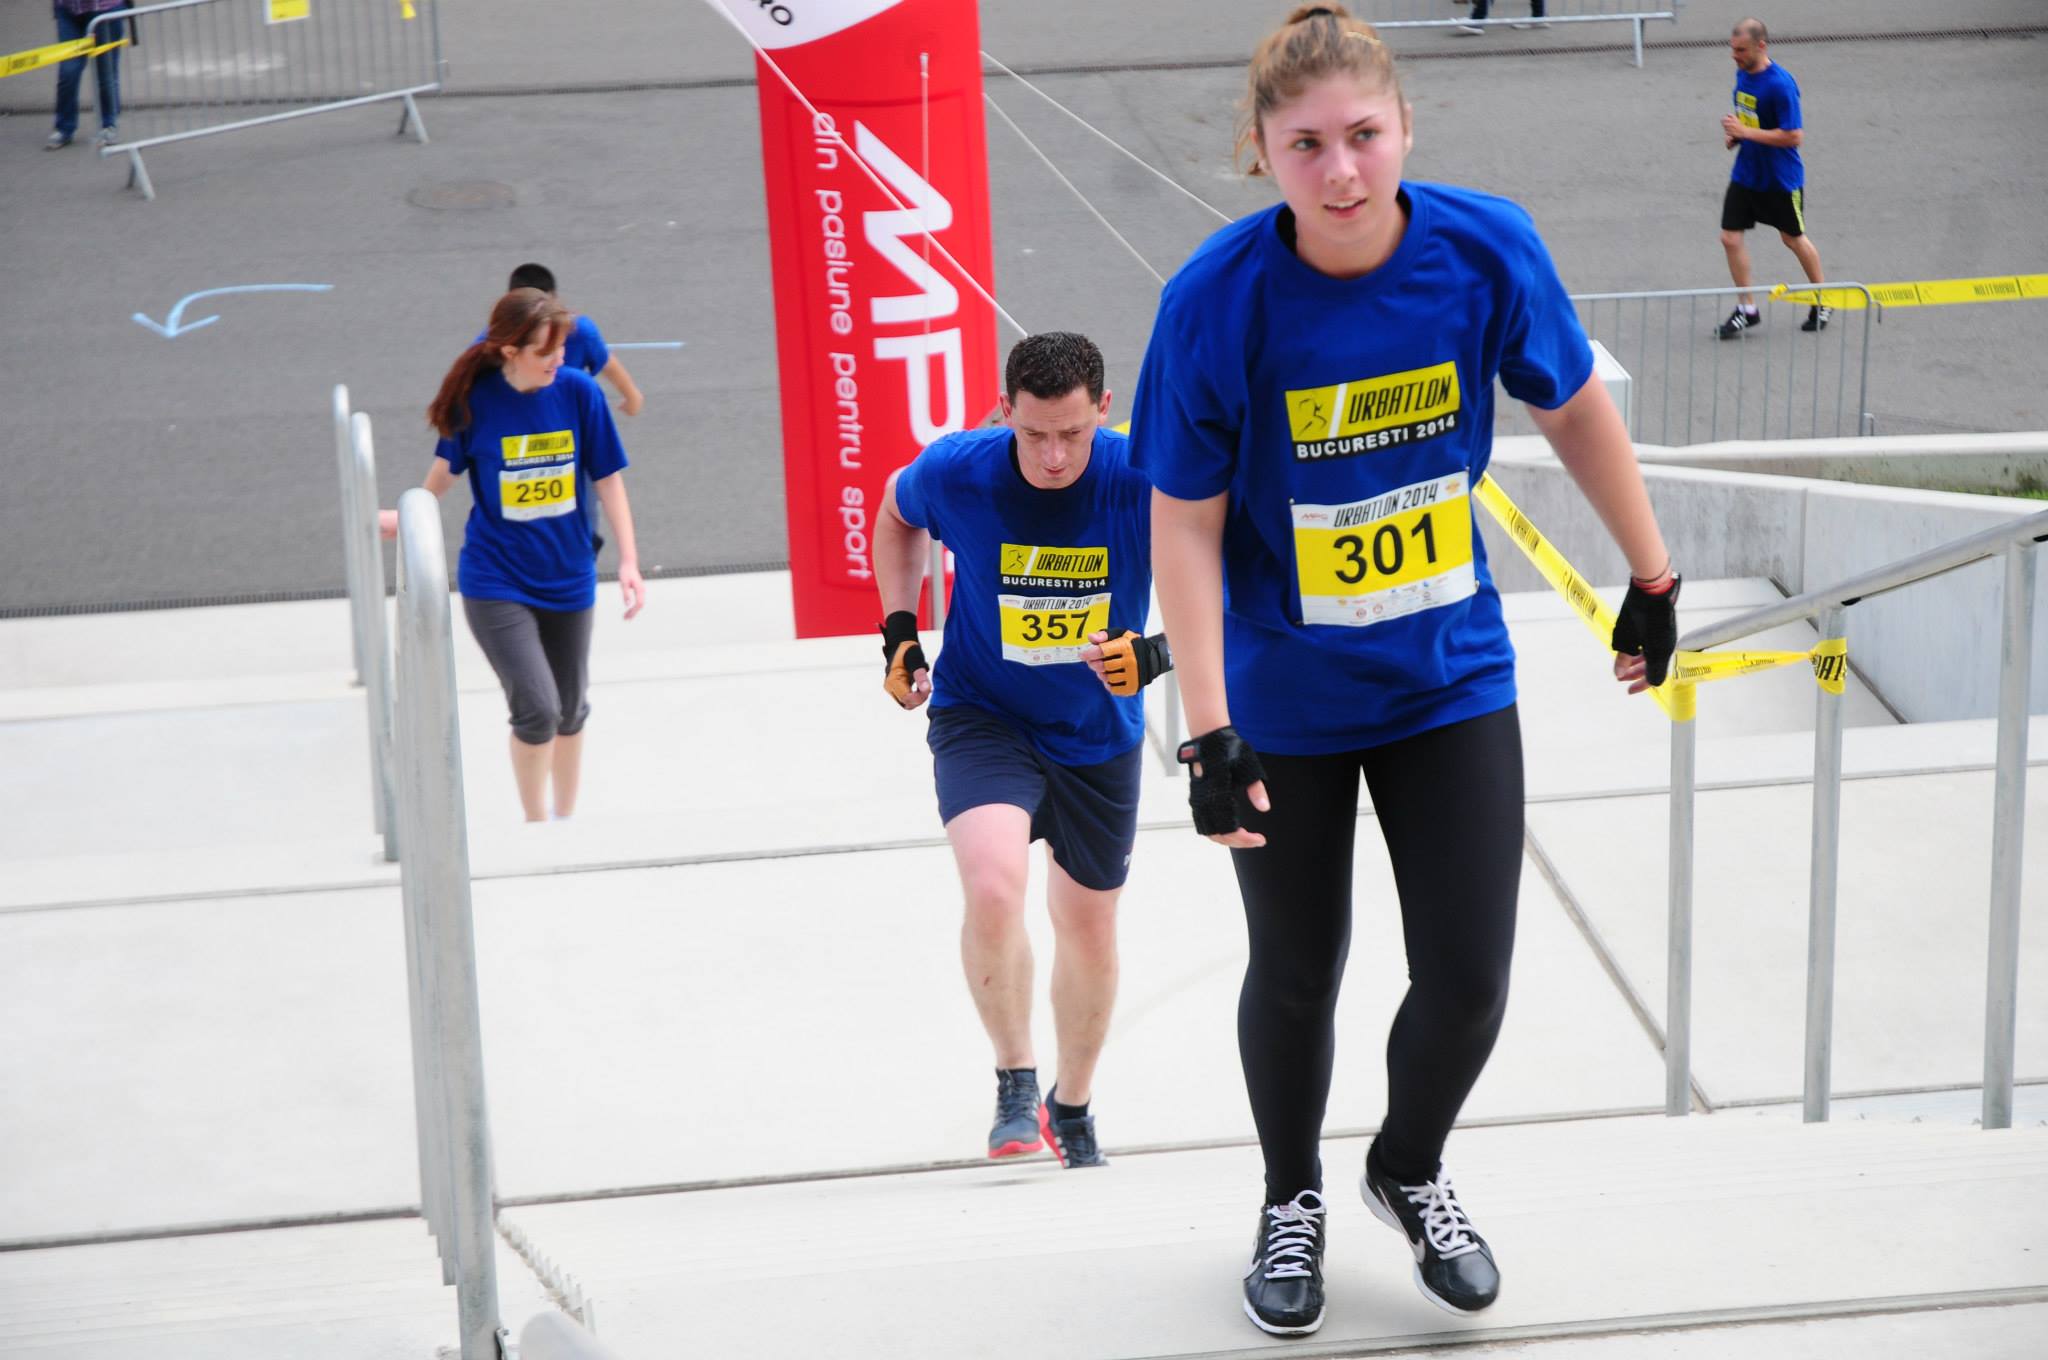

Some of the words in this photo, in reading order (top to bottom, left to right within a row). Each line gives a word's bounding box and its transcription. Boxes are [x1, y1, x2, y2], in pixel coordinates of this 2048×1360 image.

[812, 111, 842, 170] din
[815, 188, 854, 335] pasiune
[853, 119, 967, 576] MP
[829, 352, 865, 469] pentru
[1347, 375, 1452, 424] URBATLON
[1296, 428, 1408, 459] BUCURESTI
[1416, 414, 1456, 439] 2014
[516, 479, 562, 503] 250
[1402, 482, 1439, 511] 2014
[837, 486, 873, 580] sport
[1333, 512, 1438, 585] 301
[1002, 576, 1073, 588] BUCURESTI
[1078, 578, 1106, 588] 2014
[1036, 553, 1104, 572] URBATLON
[1022, 610, 1090, 642] 357
[1068, 597, 1093, 609] 2014
